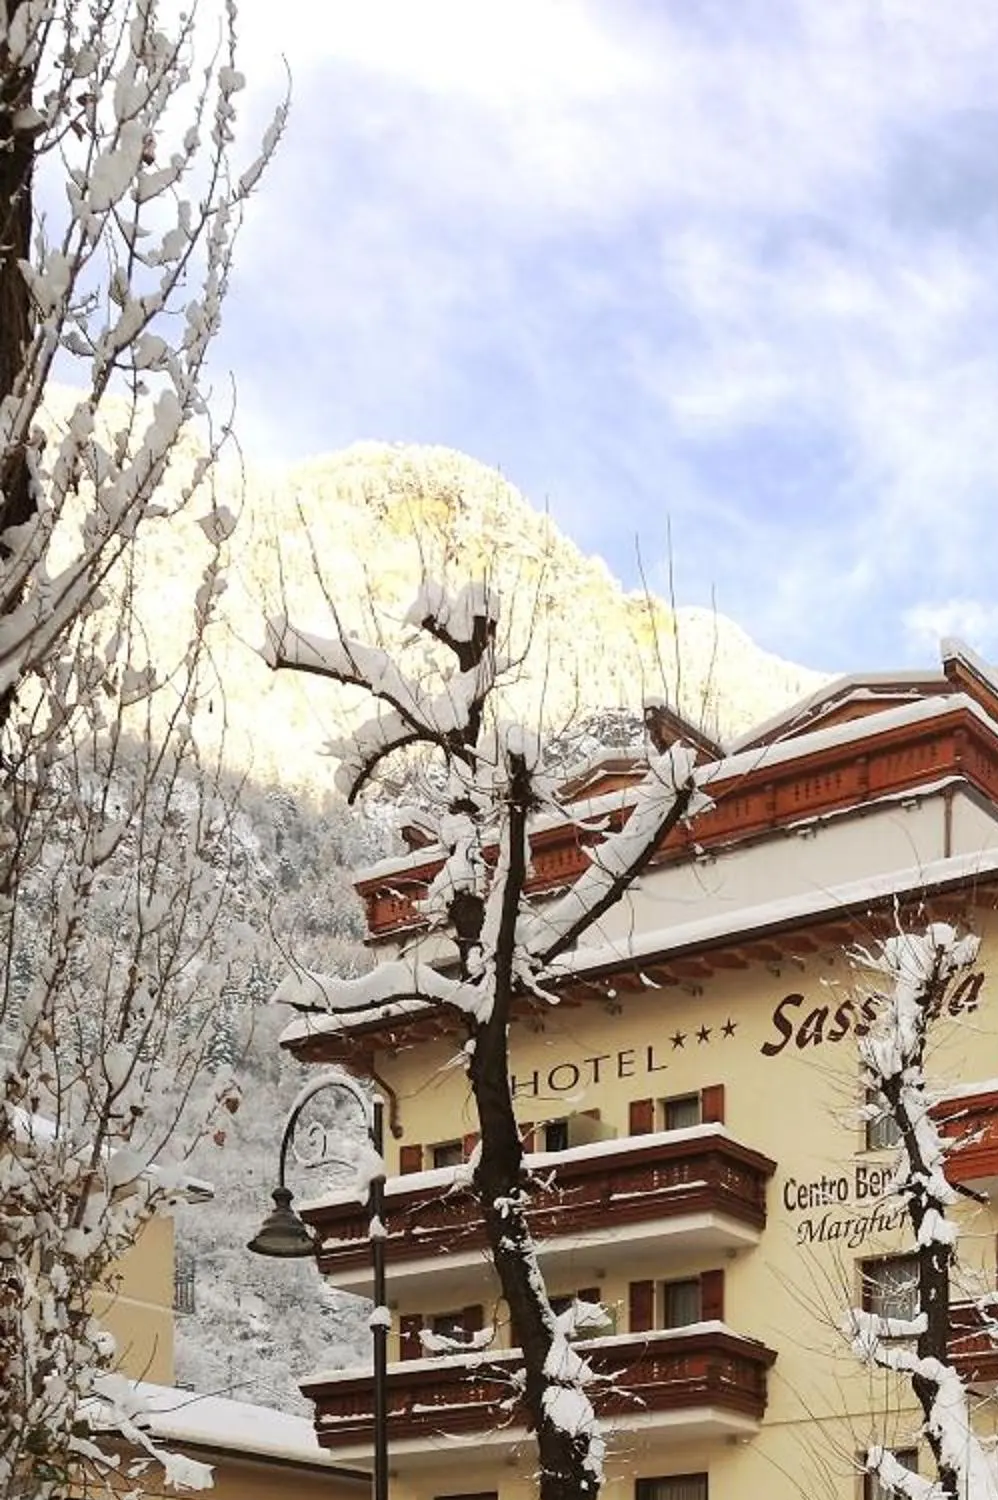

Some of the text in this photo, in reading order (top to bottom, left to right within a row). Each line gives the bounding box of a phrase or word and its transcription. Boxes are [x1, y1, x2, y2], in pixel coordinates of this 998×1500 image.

[511, 1045, 668, 1096] HOTEL
[760, 971, 985, 1057] Sassa
[783, 1175, 849, 1211] Centro
[797, 1203, 910, 1248] Margher
